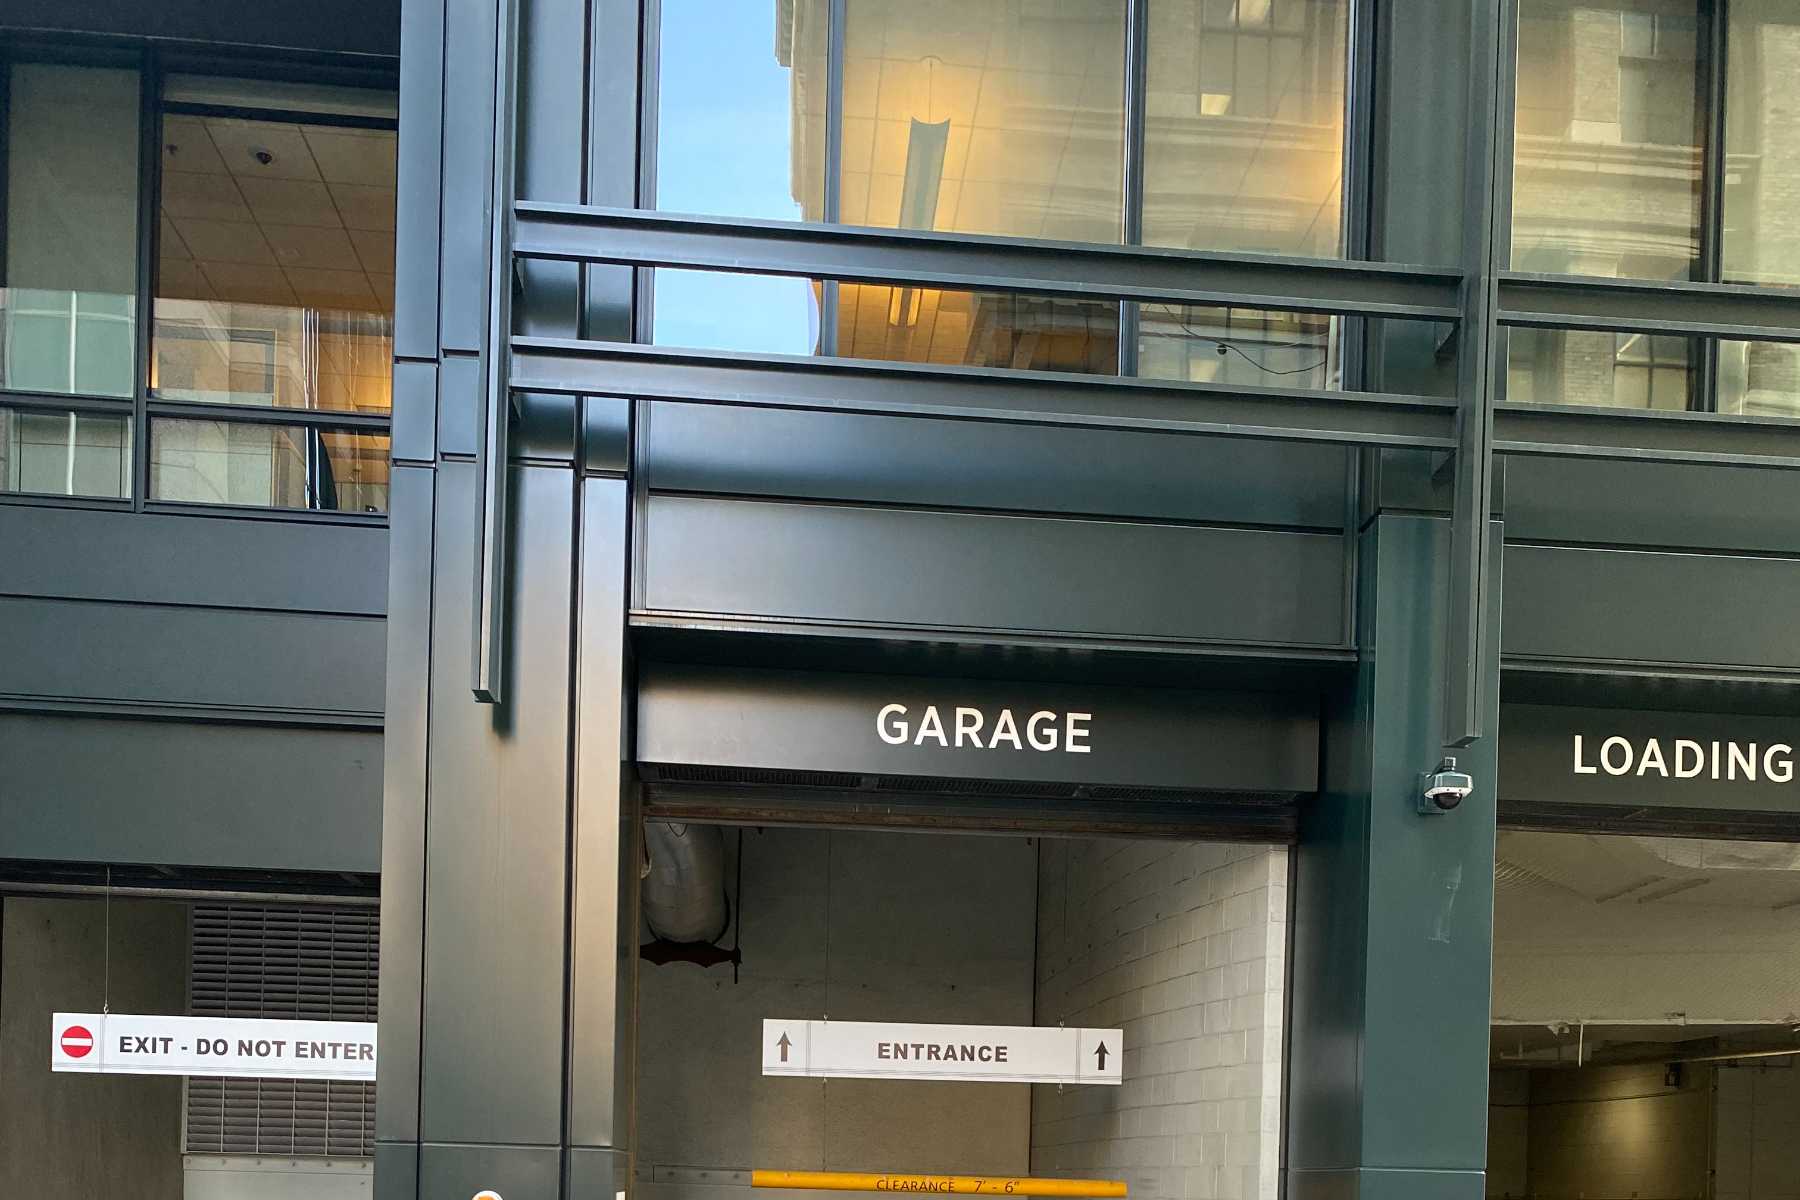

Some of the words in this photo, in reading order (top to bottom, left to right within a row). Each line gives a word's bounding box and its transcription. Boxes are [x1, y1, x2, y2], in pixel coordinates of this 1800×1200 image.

[876, 703, 1092, 753] GARAGE
[1574, 735, 1794, 783] LOADING
[119, 1035, 174, 1054] EXIT
[196, 1038, 229, 1056] DO
[237, 1039, 287, 1058] NOT
[295, 1041, 375, 1061] ENTER
[877, 1042, 1009, 1063] ENTRANCE
[876, 1179, 955, 1193] CLEARANCE
